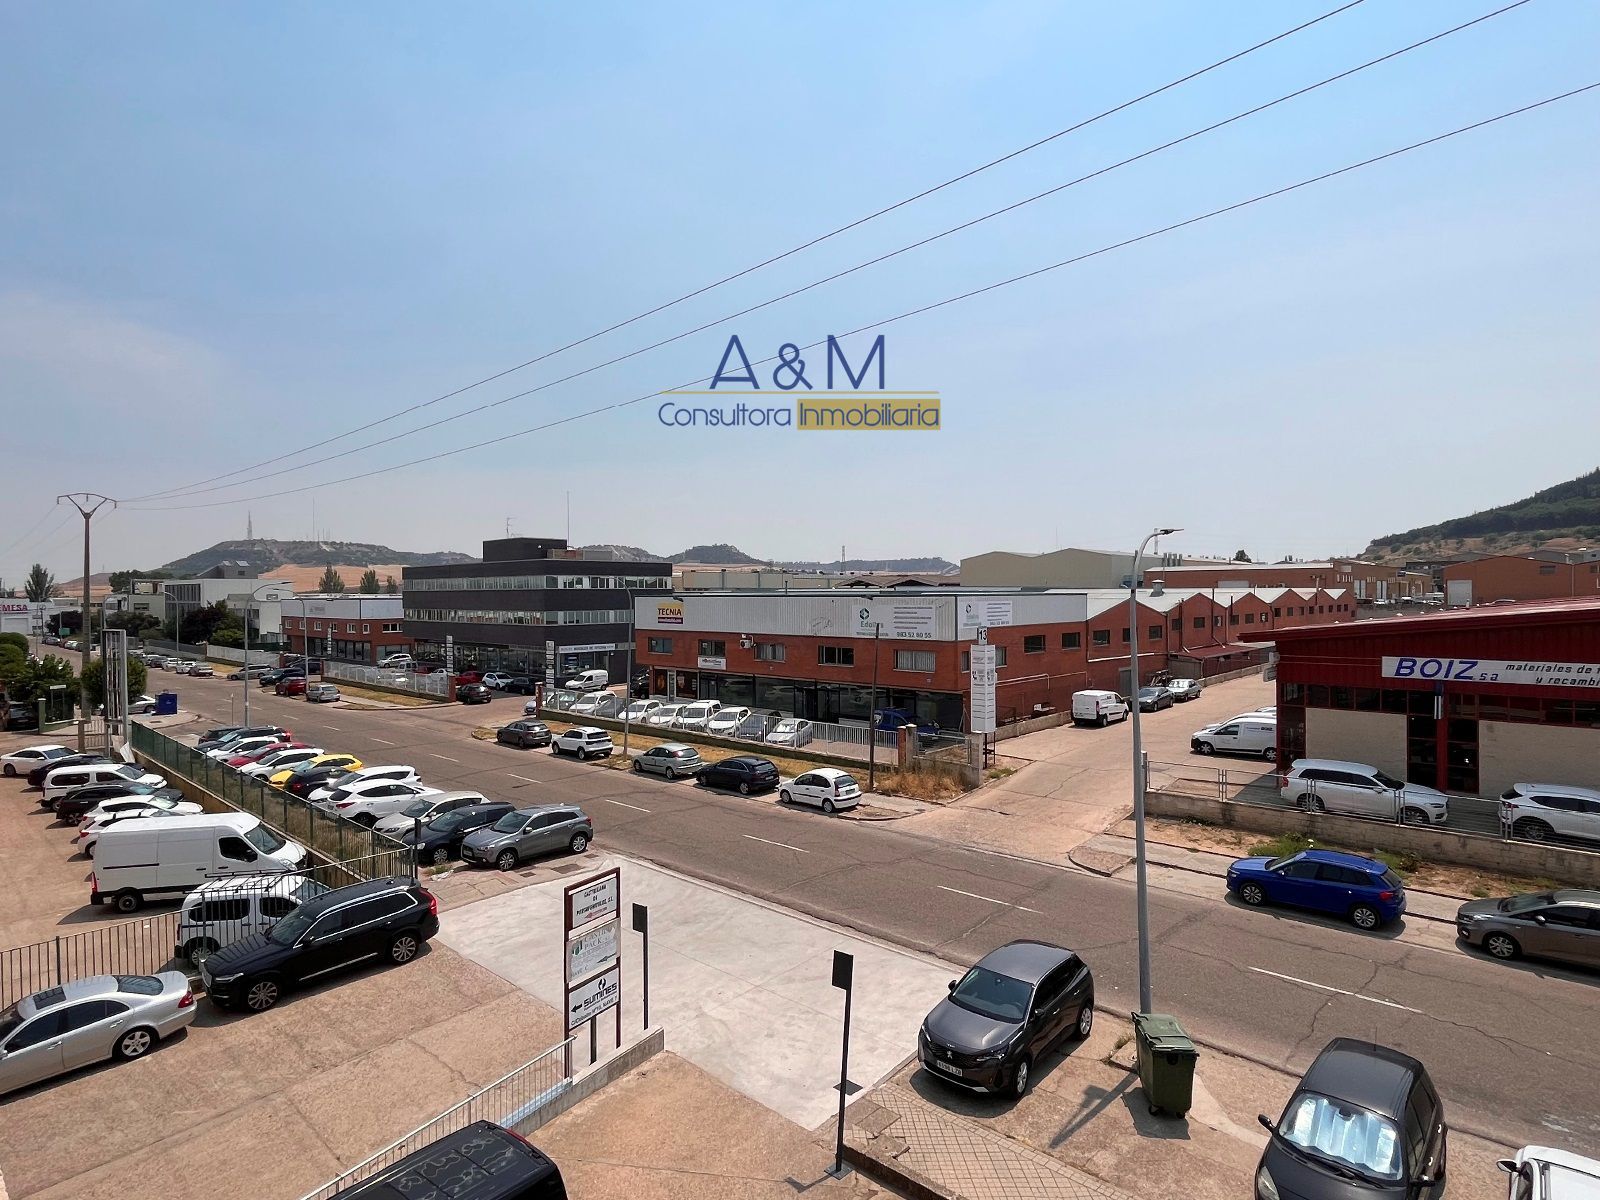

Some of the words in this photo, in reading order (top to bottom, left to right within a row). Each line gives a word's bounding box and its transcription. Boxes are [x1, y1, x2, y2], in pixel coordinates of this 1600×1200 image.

[657, 608, 682, 616] TECNIA
[979, 629, 987, 641] 13
[1394, 657, 1478, 681] BOIZ
[1505, 662, 1572, 674] materiales
[1576, 664, 1592, 674] de
